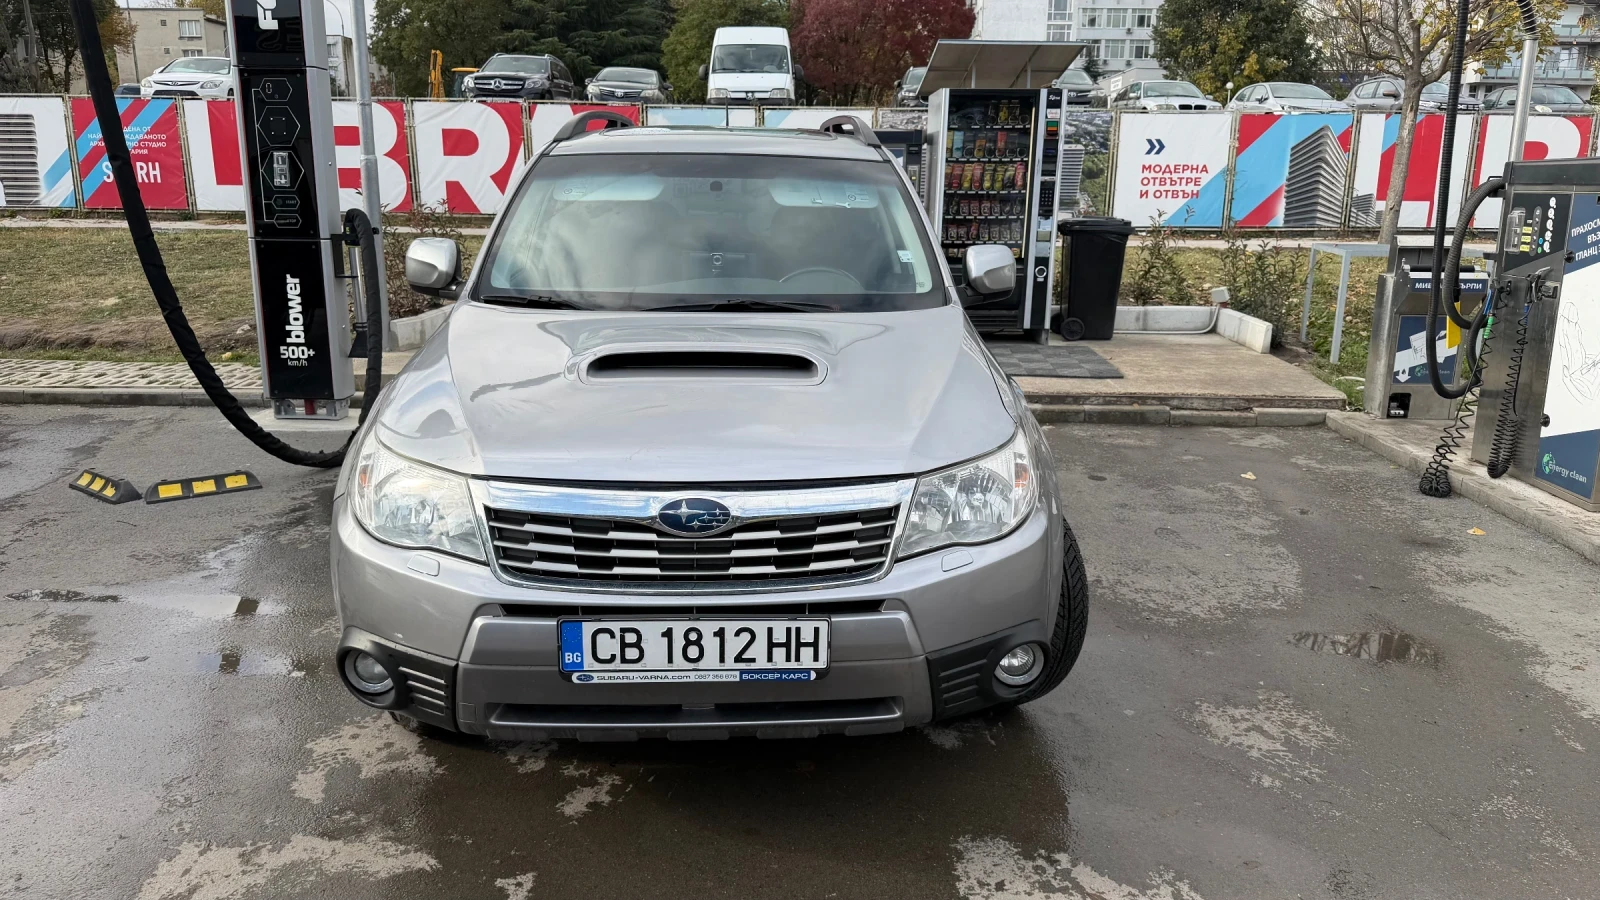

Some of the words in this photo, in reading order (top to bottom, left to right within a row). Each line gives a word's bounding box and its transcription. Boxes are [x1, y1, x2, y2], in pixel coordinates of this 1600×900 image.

[140, 141, 167, 149] СТУДИО
[1141, 164, 1209, 176] МОДЕРНА
[1140, 176, 1202, 187] ОТВЪТРЕ
[1139, 189, 1149, 199] И
[1153, 189, 1200, 199] ОТВЪН
[285, 274, 305, 343] blower
[280, 346, 315, 359] 500+
[287, 359, 308, 367] km/h
[1548, 460, 1570, 478] Energy
[1569, 470, 1587, 483] clean
[591, 627, 645, 664] CB
[661, 626, 757, 664] 1812
[767, 626, 820, 663] HH
[564, 652, 582, 664] BG
[742, 672, 780, 680] БОКСЕР
[782, 672, 809, 680] КАРС
